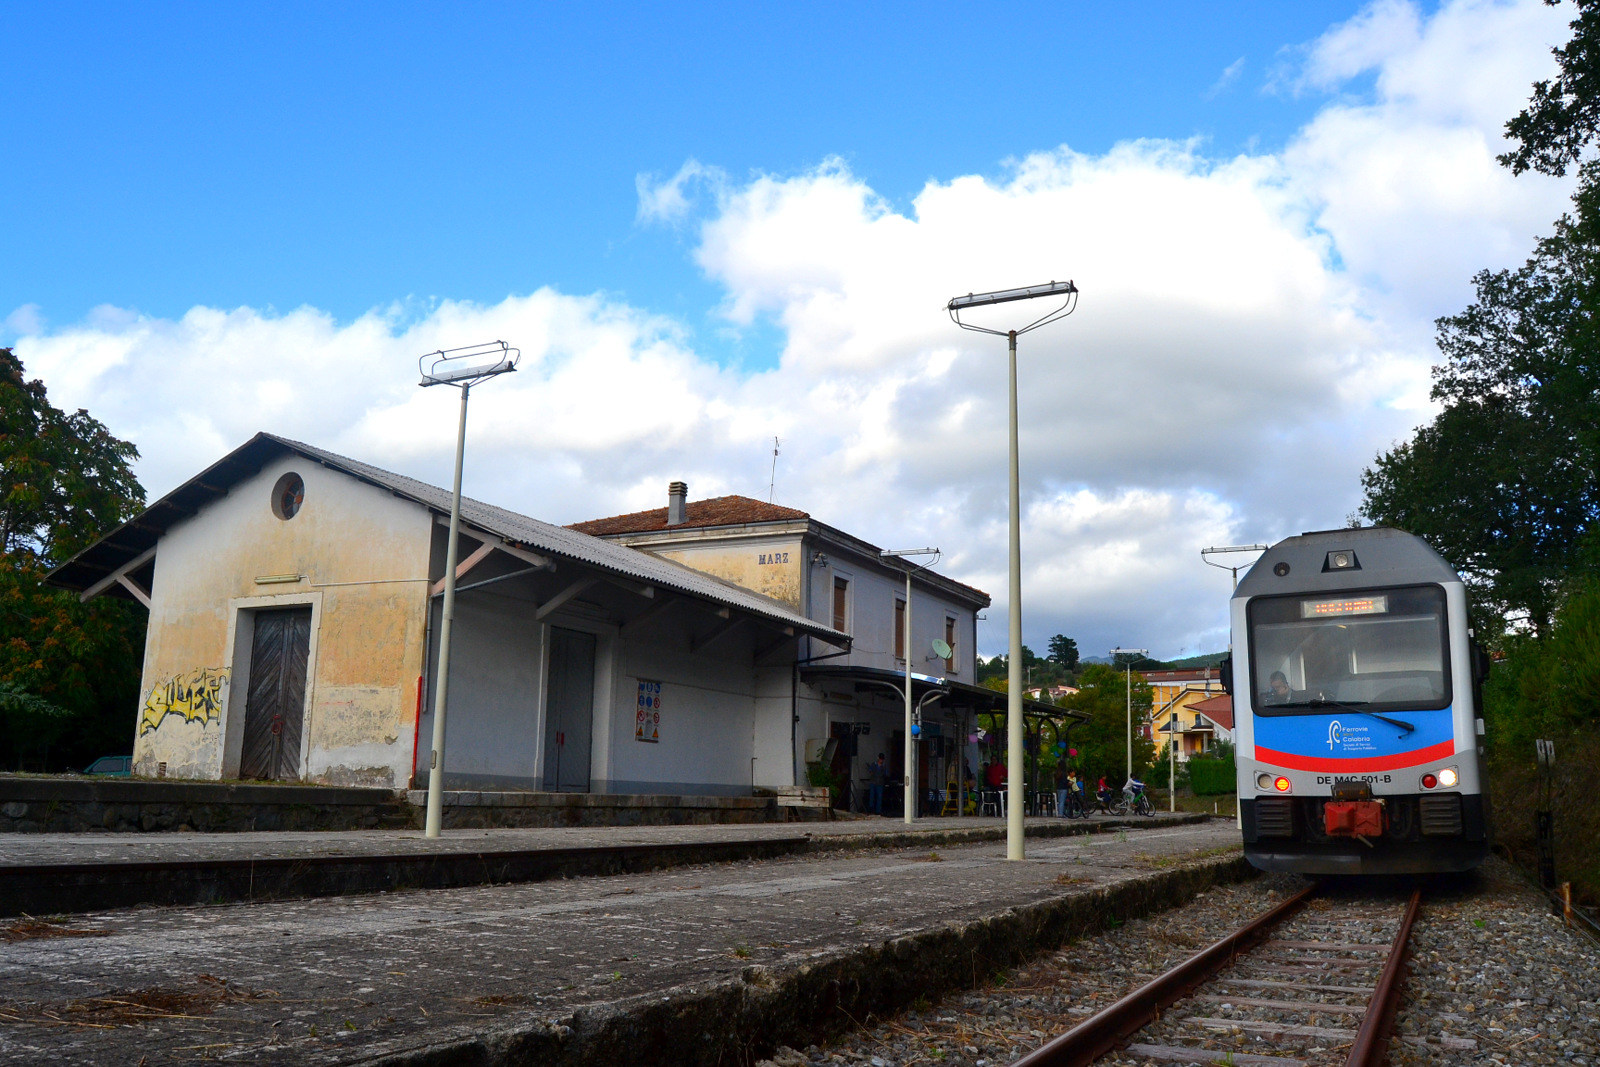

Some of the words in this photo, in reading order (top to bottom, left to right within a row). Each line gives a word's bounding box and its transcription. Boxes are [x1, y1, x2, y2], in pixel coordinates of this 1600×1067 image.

[1316, 776, 1332, 784] DE
[1334, 775, 1358, 783] M4C
[1361, 774, 1392, 784] 501-B
